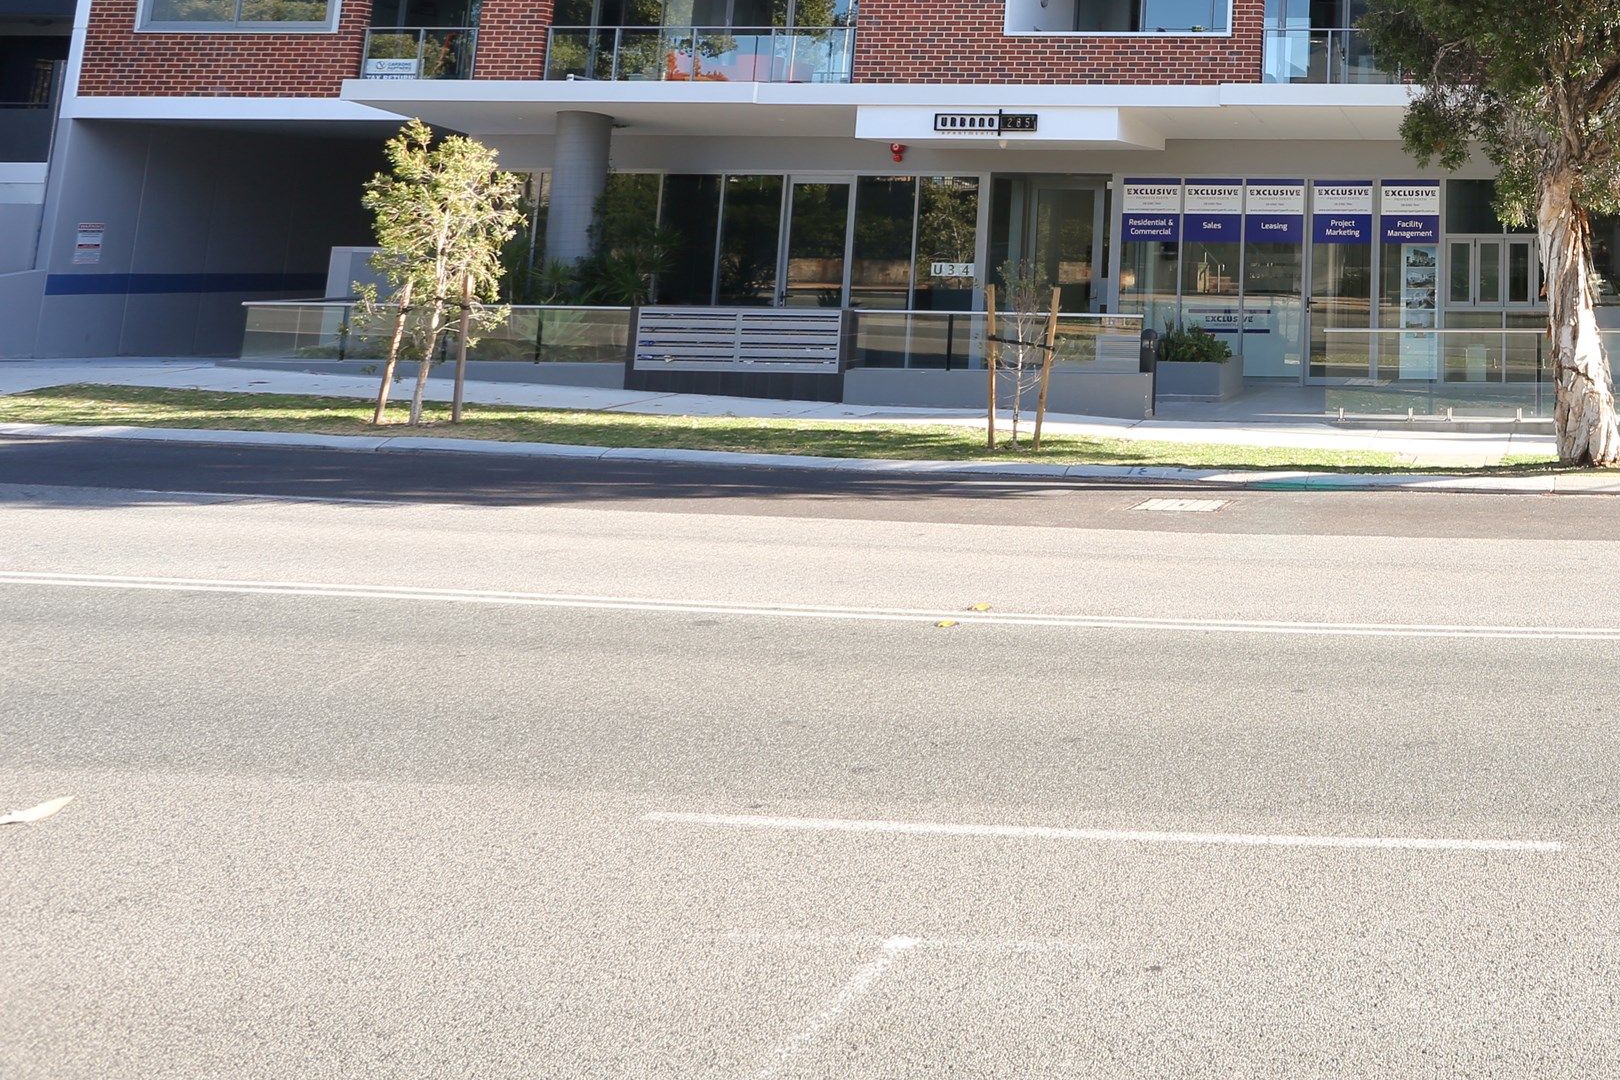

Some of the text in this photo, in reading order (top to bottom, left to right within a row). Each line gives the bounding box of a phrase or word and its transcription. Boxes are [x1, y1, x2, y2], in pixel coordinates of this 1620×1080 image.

[1188, 188, 1239, 196] EXCLUSIVE
[1128, 219, 1166, 227] Residential
[1202, 222, 1222, 230] Sales
[1261, 222, 1288, 232] Leasing
[1330, 220, 1355, 228] Project
[1397, 220, 1423, 229] Facility
[1325, 229, 1360, 238] Marketing
[1387, 230, 1432, 239] Management
